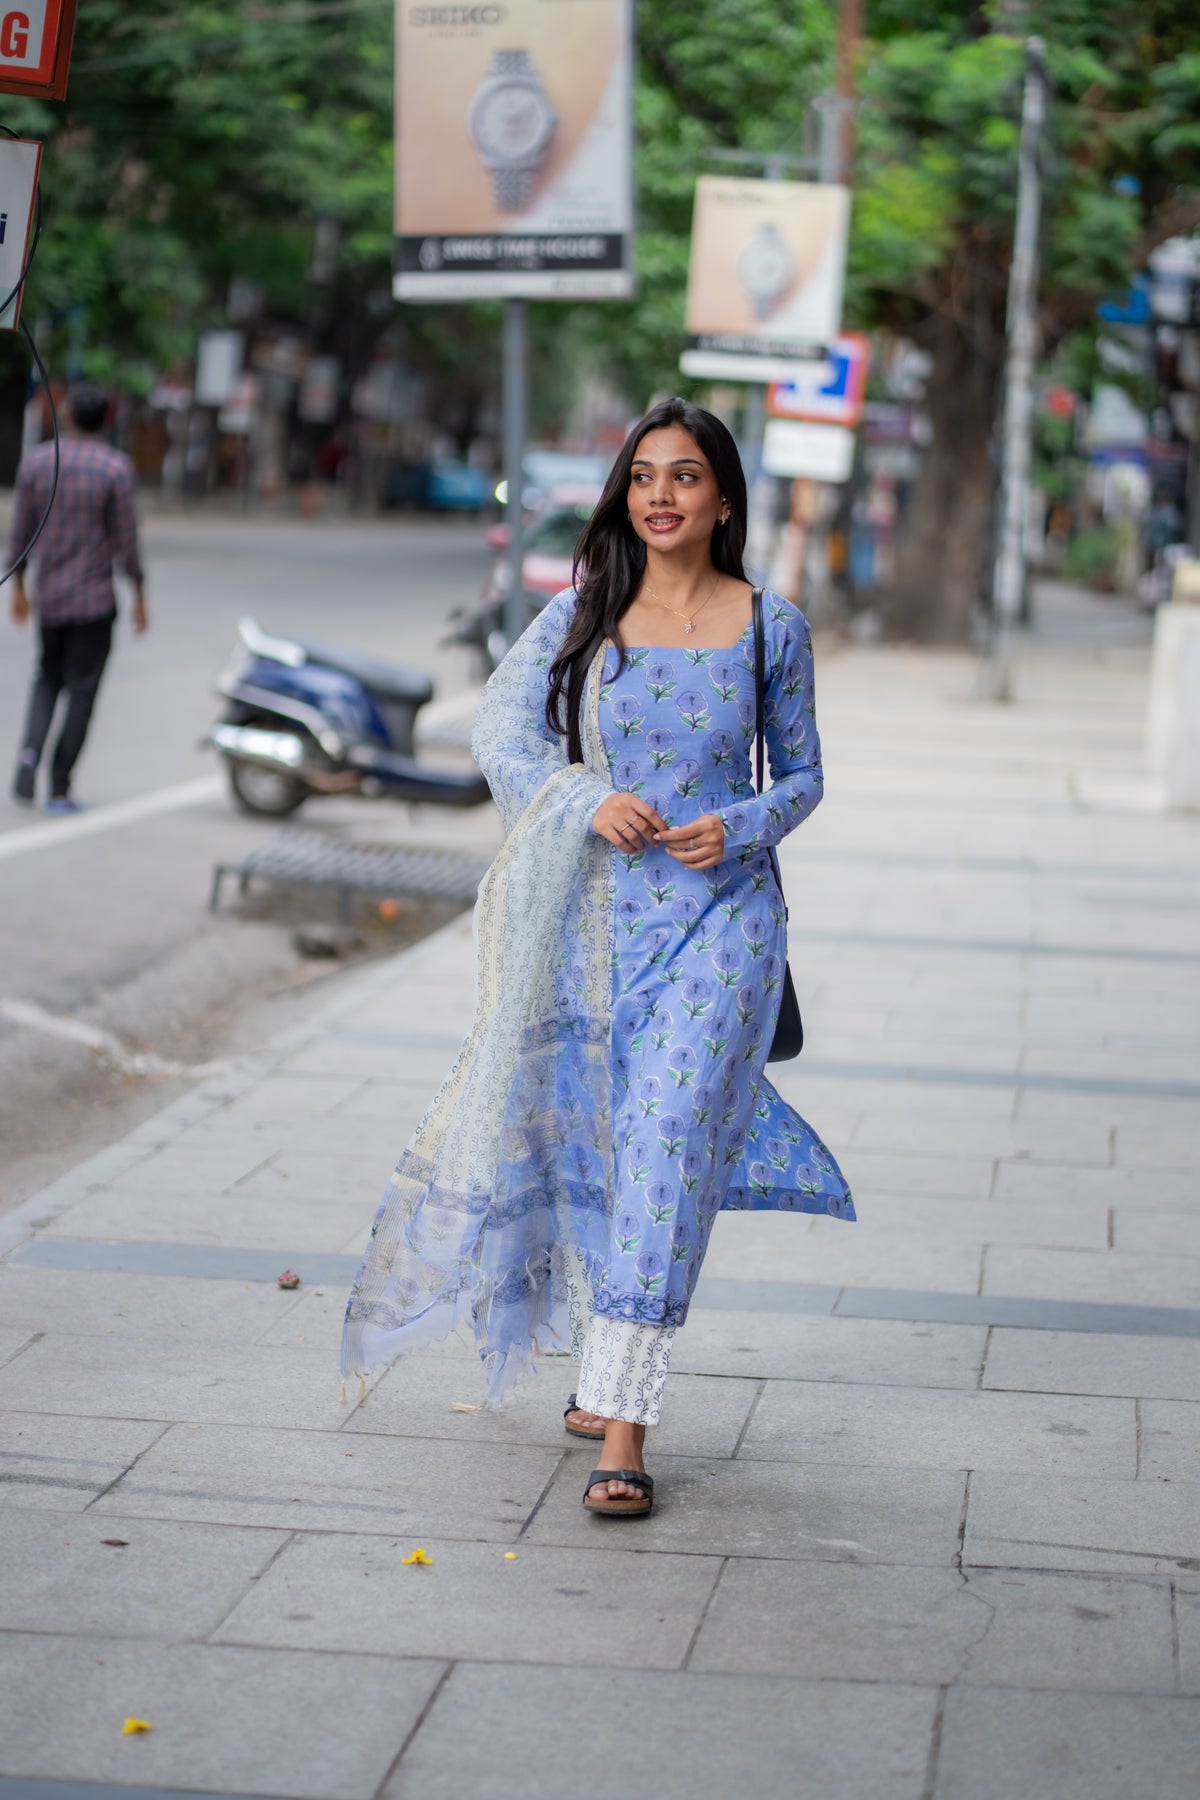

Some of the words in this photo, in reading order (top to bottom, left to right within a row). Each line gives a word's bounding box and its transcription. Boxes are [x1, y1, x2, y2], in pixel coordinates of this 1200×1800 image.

[408, 6, 504, 26] SEIKO
[0, 11, 29, 59] G
[539, 237, 605, 258] HOUSE
